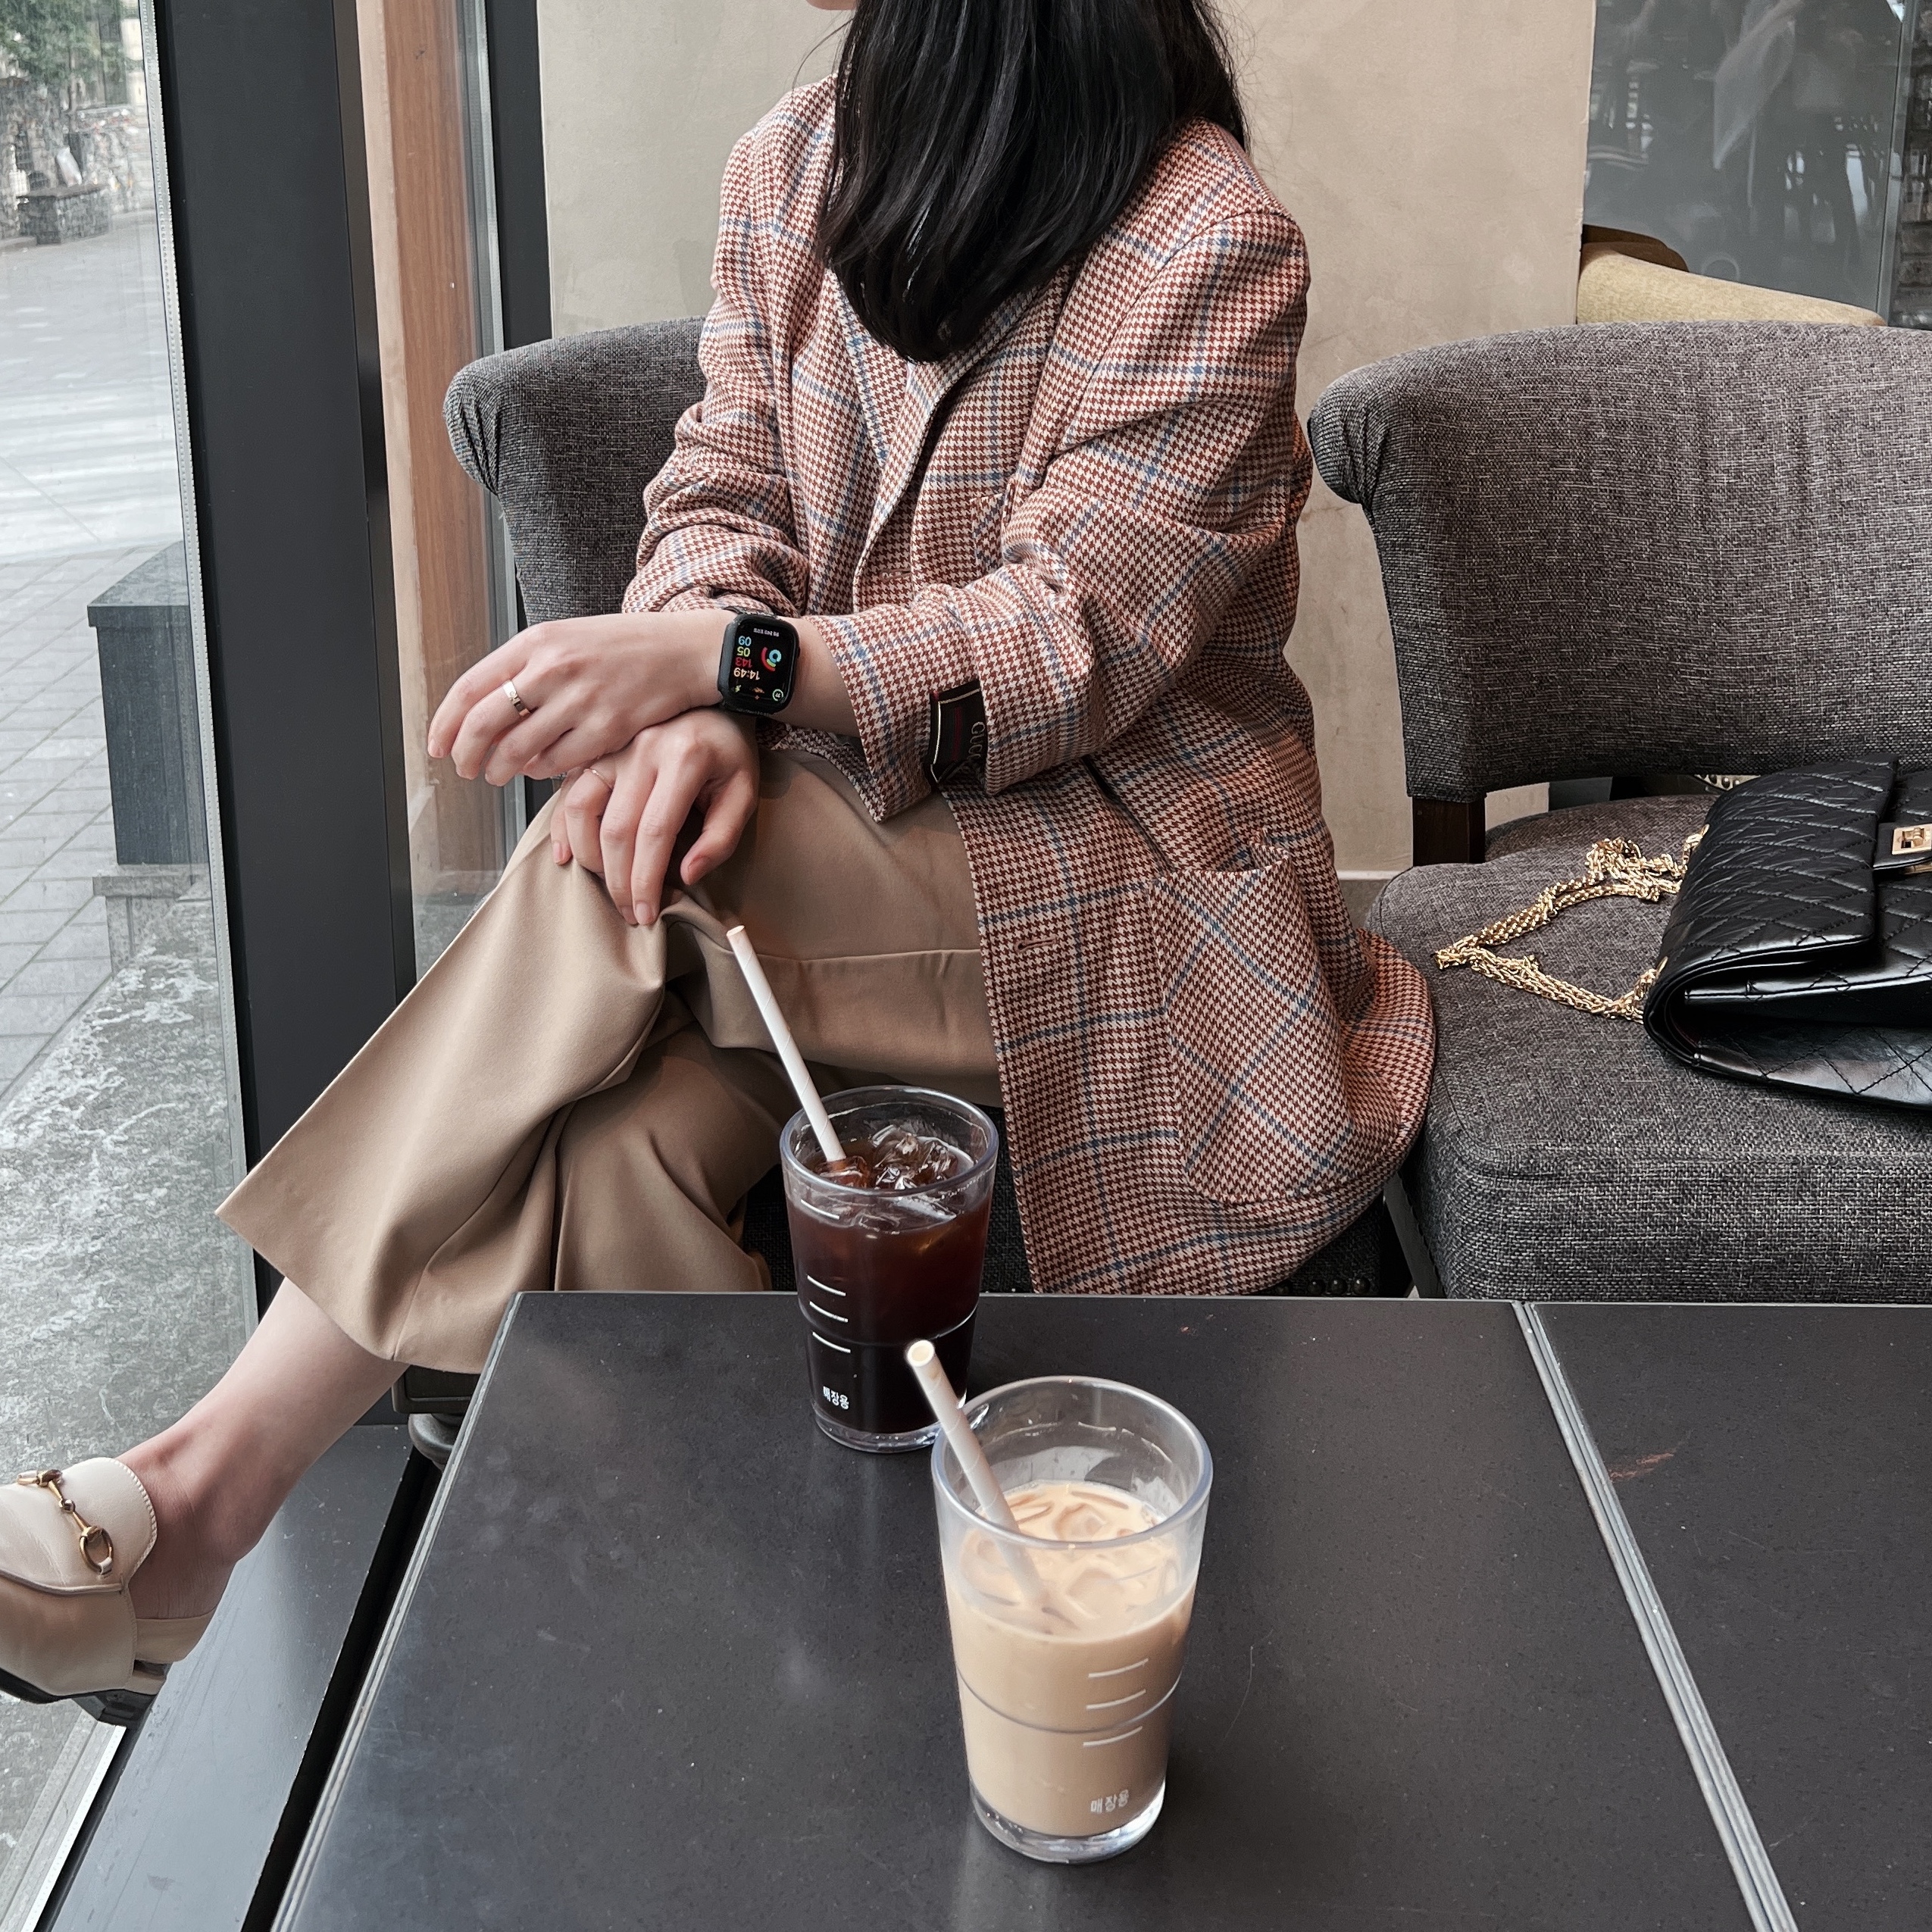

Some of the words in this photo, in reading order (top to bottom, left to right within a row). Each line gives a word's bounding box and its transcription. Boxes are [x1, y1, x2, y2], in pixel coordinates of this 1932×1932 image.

[738, 635, 752, 647] 09
[736, 646, 751, 658] 05
[735, 657, 753, 667] 143
[733, 667, 760, 680] 14:49
[968, 721, 986, 760] GUCC
[823, 1386, 849, 1410] 매장용
[1090, 1789, 1129, 1814] 매장용
